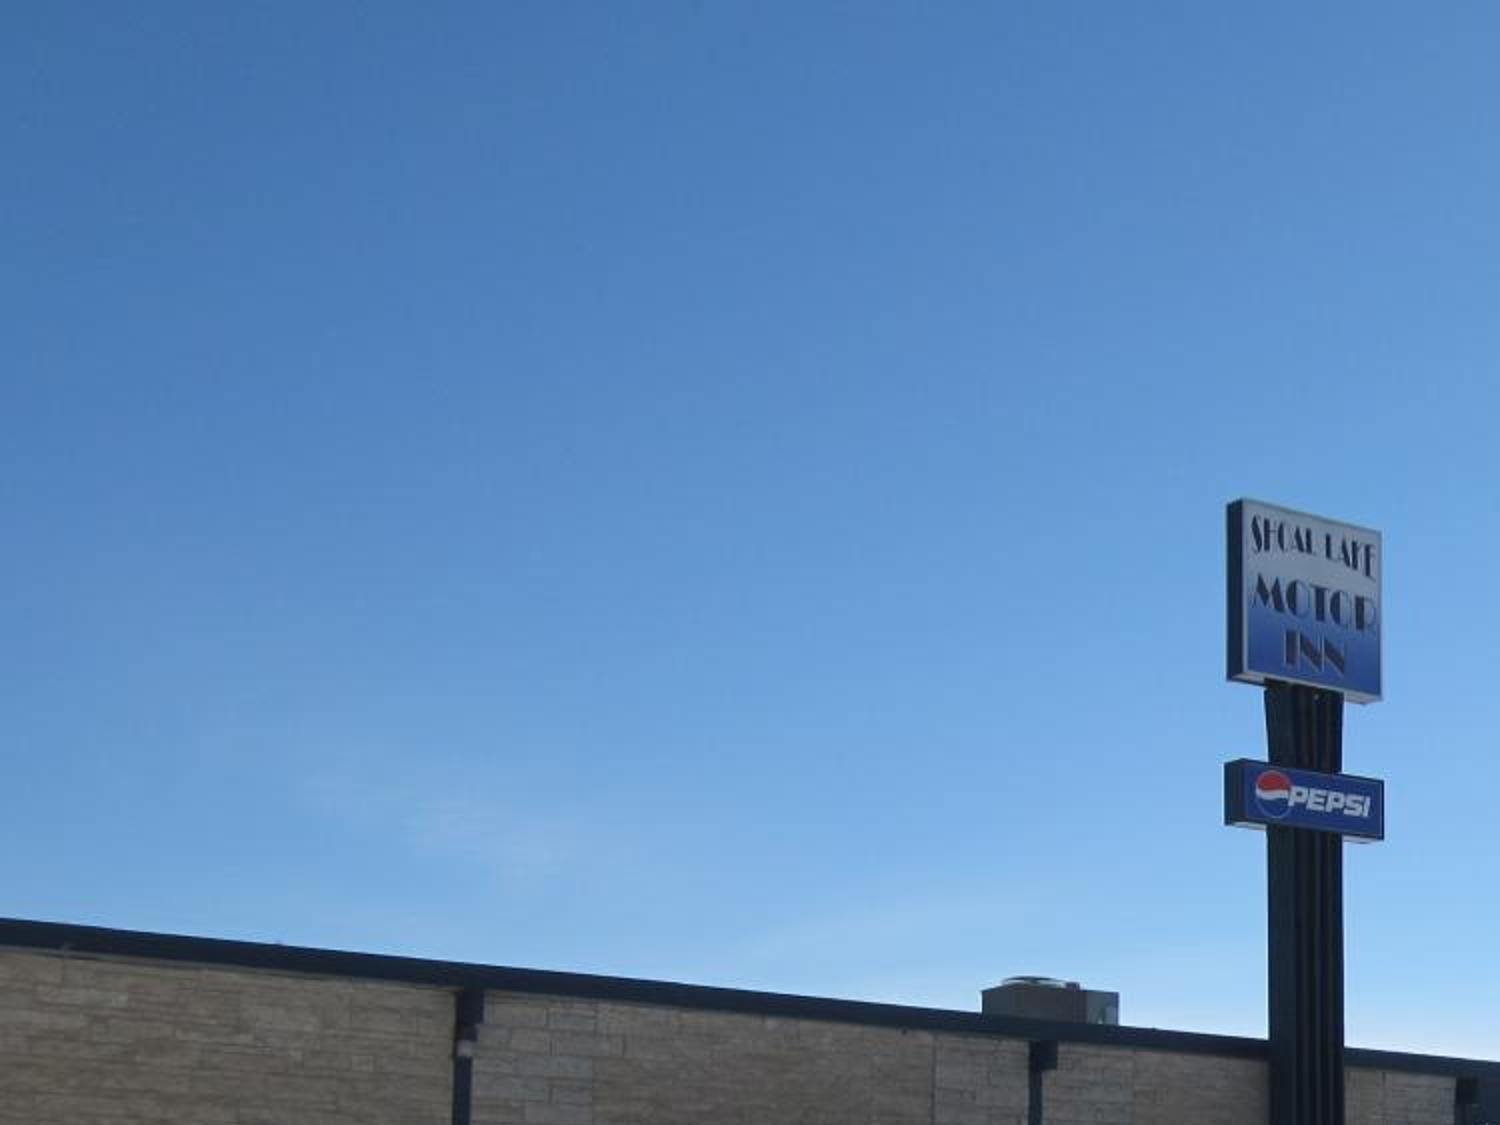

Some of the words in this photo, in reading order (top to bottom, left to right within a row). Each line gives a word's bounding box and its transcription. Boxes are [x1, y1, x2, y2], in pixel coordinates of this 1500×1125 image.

[1251, 515, 1316, 555] SHOAL
[1325, 533, 1377, 581] LAKE
[1252, 573, 1377, 634] MOTOR
[1284, 630, 1345, 677] INN
[1288, 785, 1372, 819] PEPSI
